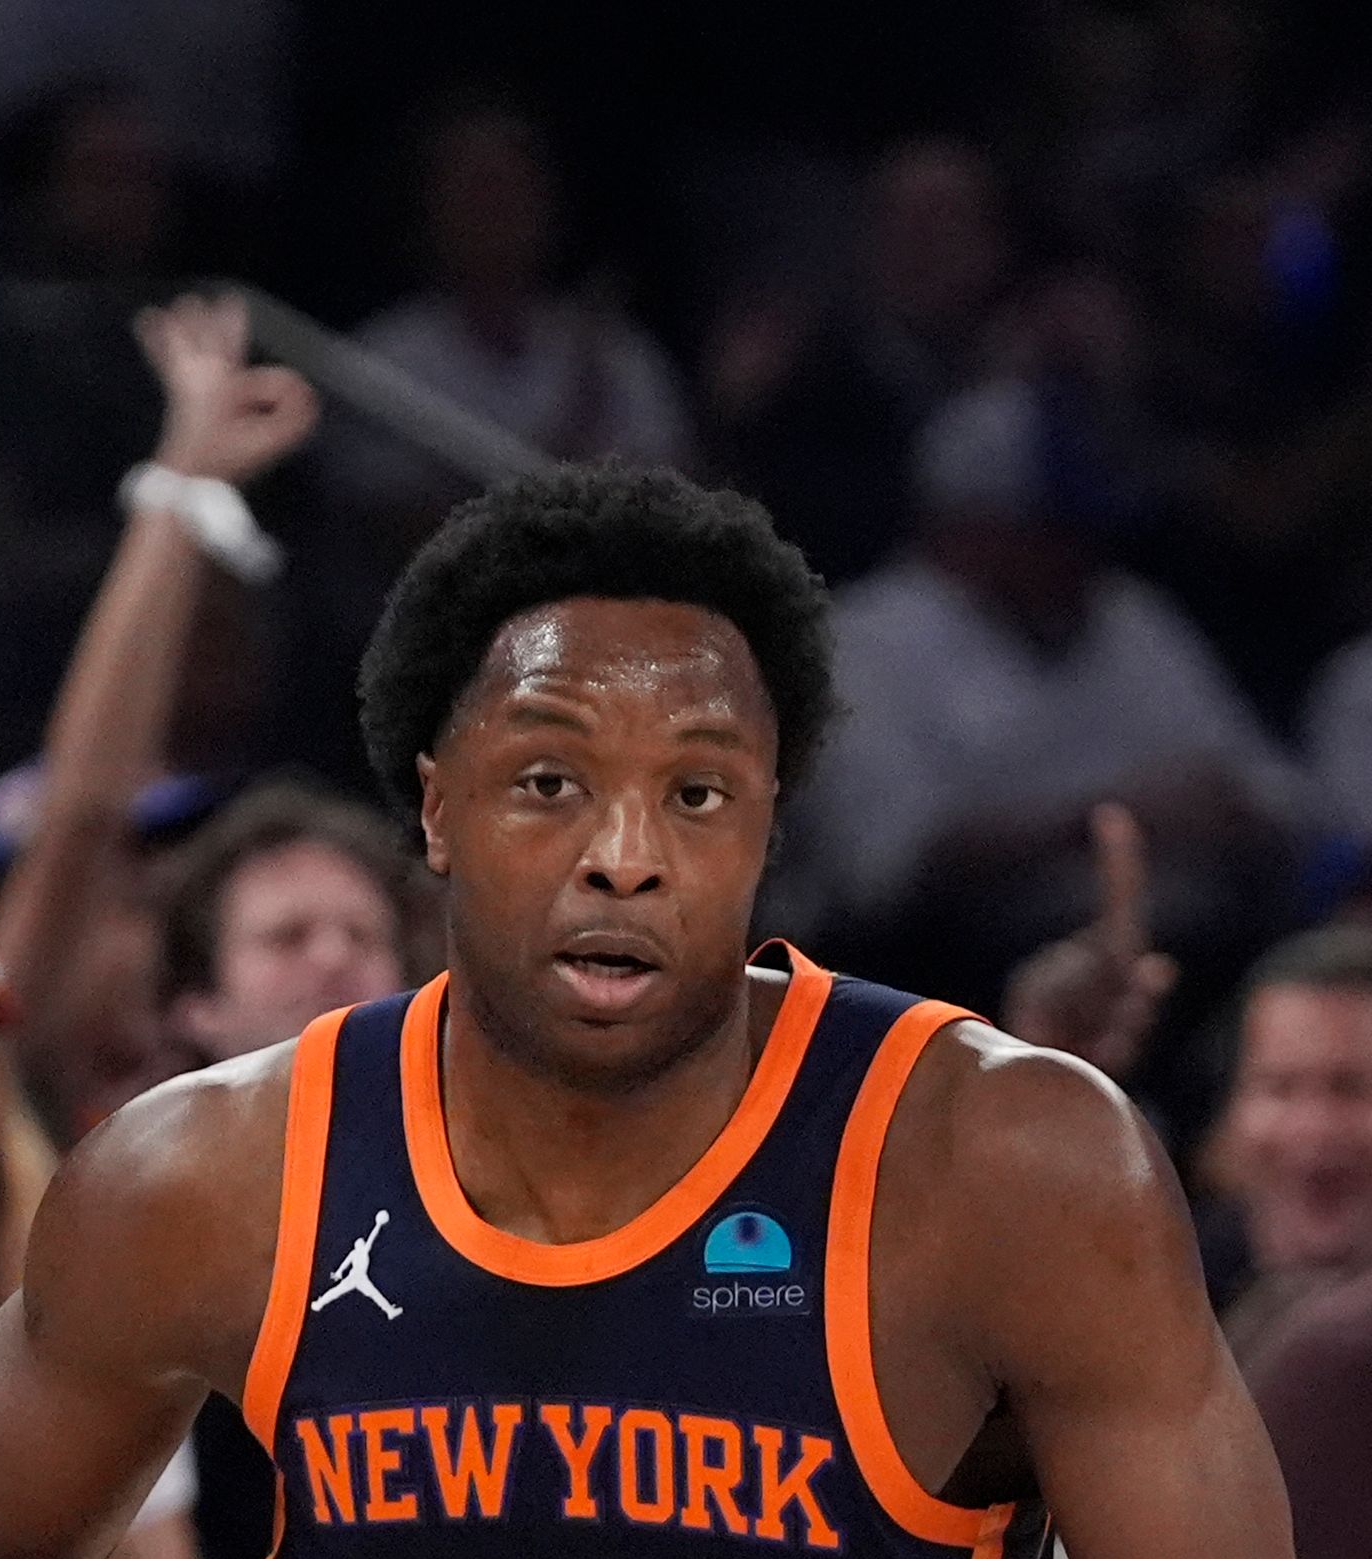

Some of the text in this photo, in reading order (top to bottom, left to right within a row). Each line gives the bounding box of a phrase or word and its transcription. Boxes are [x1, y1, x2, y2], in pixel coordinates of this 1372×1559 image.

[693, 1281, 805, 1314] sphere
[295, 1403, 839, 1549] NEW YORK
